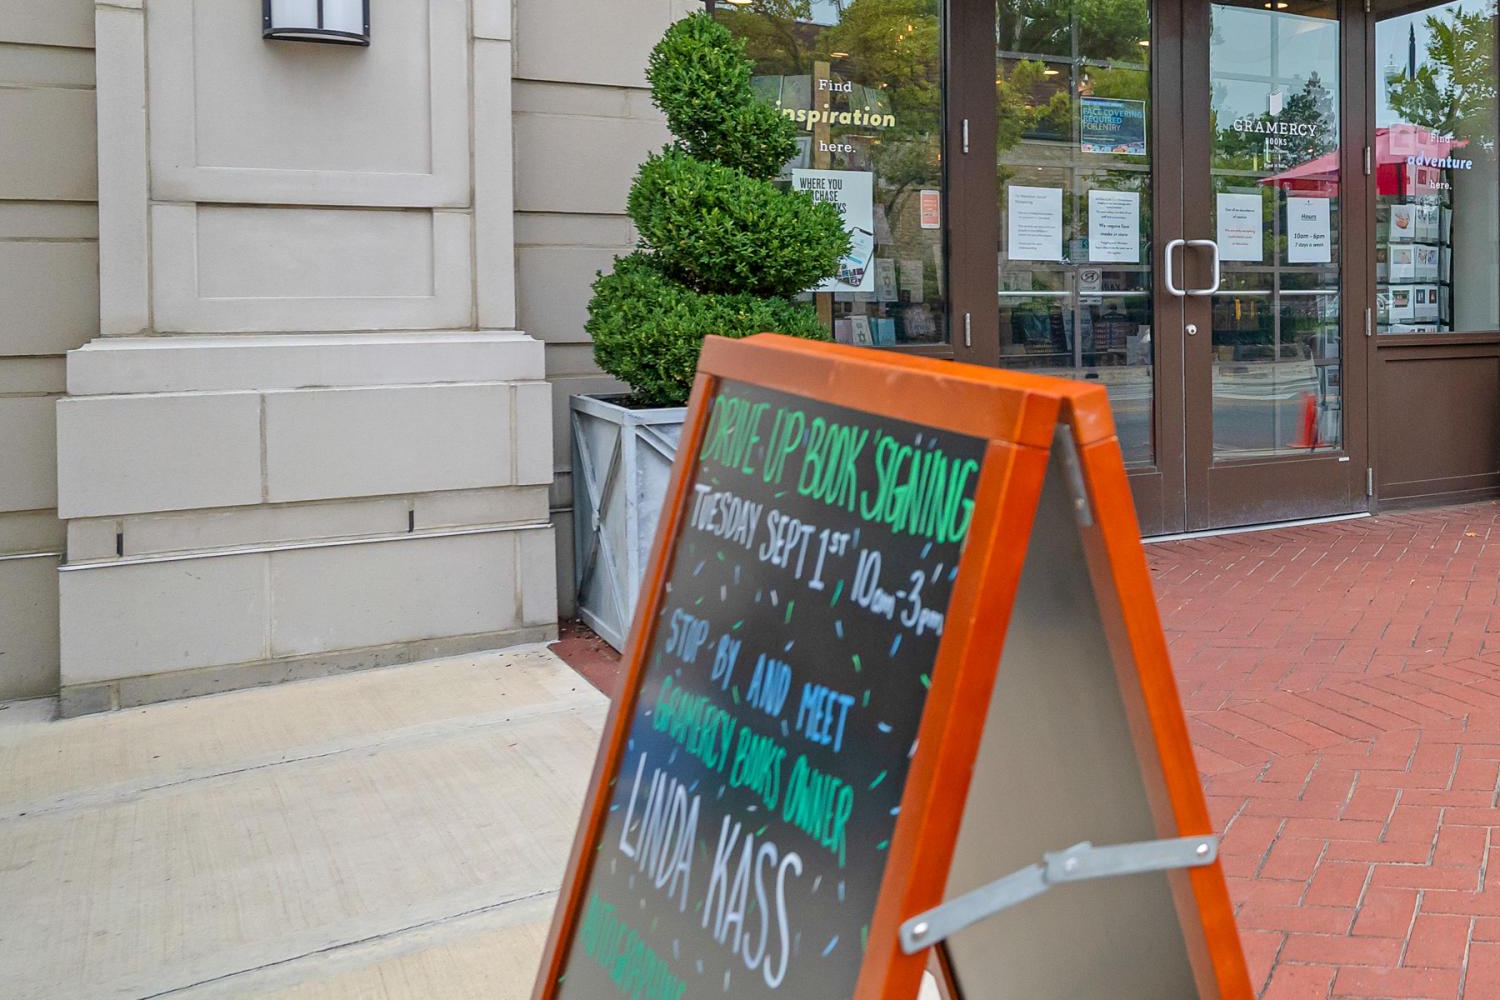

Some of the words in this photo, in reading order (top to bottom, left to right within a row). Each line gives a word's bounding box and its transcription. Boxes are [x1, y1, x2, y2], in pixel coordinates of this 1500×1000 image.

[818, 79, 852, 93] Find
[1083, 108, 1103, 116] FACE
[1104, 109, 1142, 118] COVERING
[1083, 115, 1122, 124] REQUIRED
[1233, 119, 1317, 137] GRAMERCY
[819, 140, 856, 153] here.
[1430, 133, 1451, 144] Find
[1407, 151, 1473, 170] adventure
[799, 177, 826, 189] WHERE
[827, 179, 843, 190] YOU
[1429, 180, 1452, 190] here.
[700, 395, 770, 474] DRIVE
[763, 409, 805, 484] UP
[798, 417, 869, 513] BOOK
[860, 435, 979, 544] SIGNING
[691, 484, 763, 550] TUESDAY
[759, 509, 816, 580] SEPT
[665, 607, 710, 664] STOP
[710, 633, 742, 691] BY
[745, 653, 792, 718] AND
[795, 682, 855, 753] MEET
[730, 726, 787, 811] BOOKS
[782, 753, 854, 868] OWNER
[619, 751, 701, 913] LINDA
[702, 814, 803, 989] KASS
